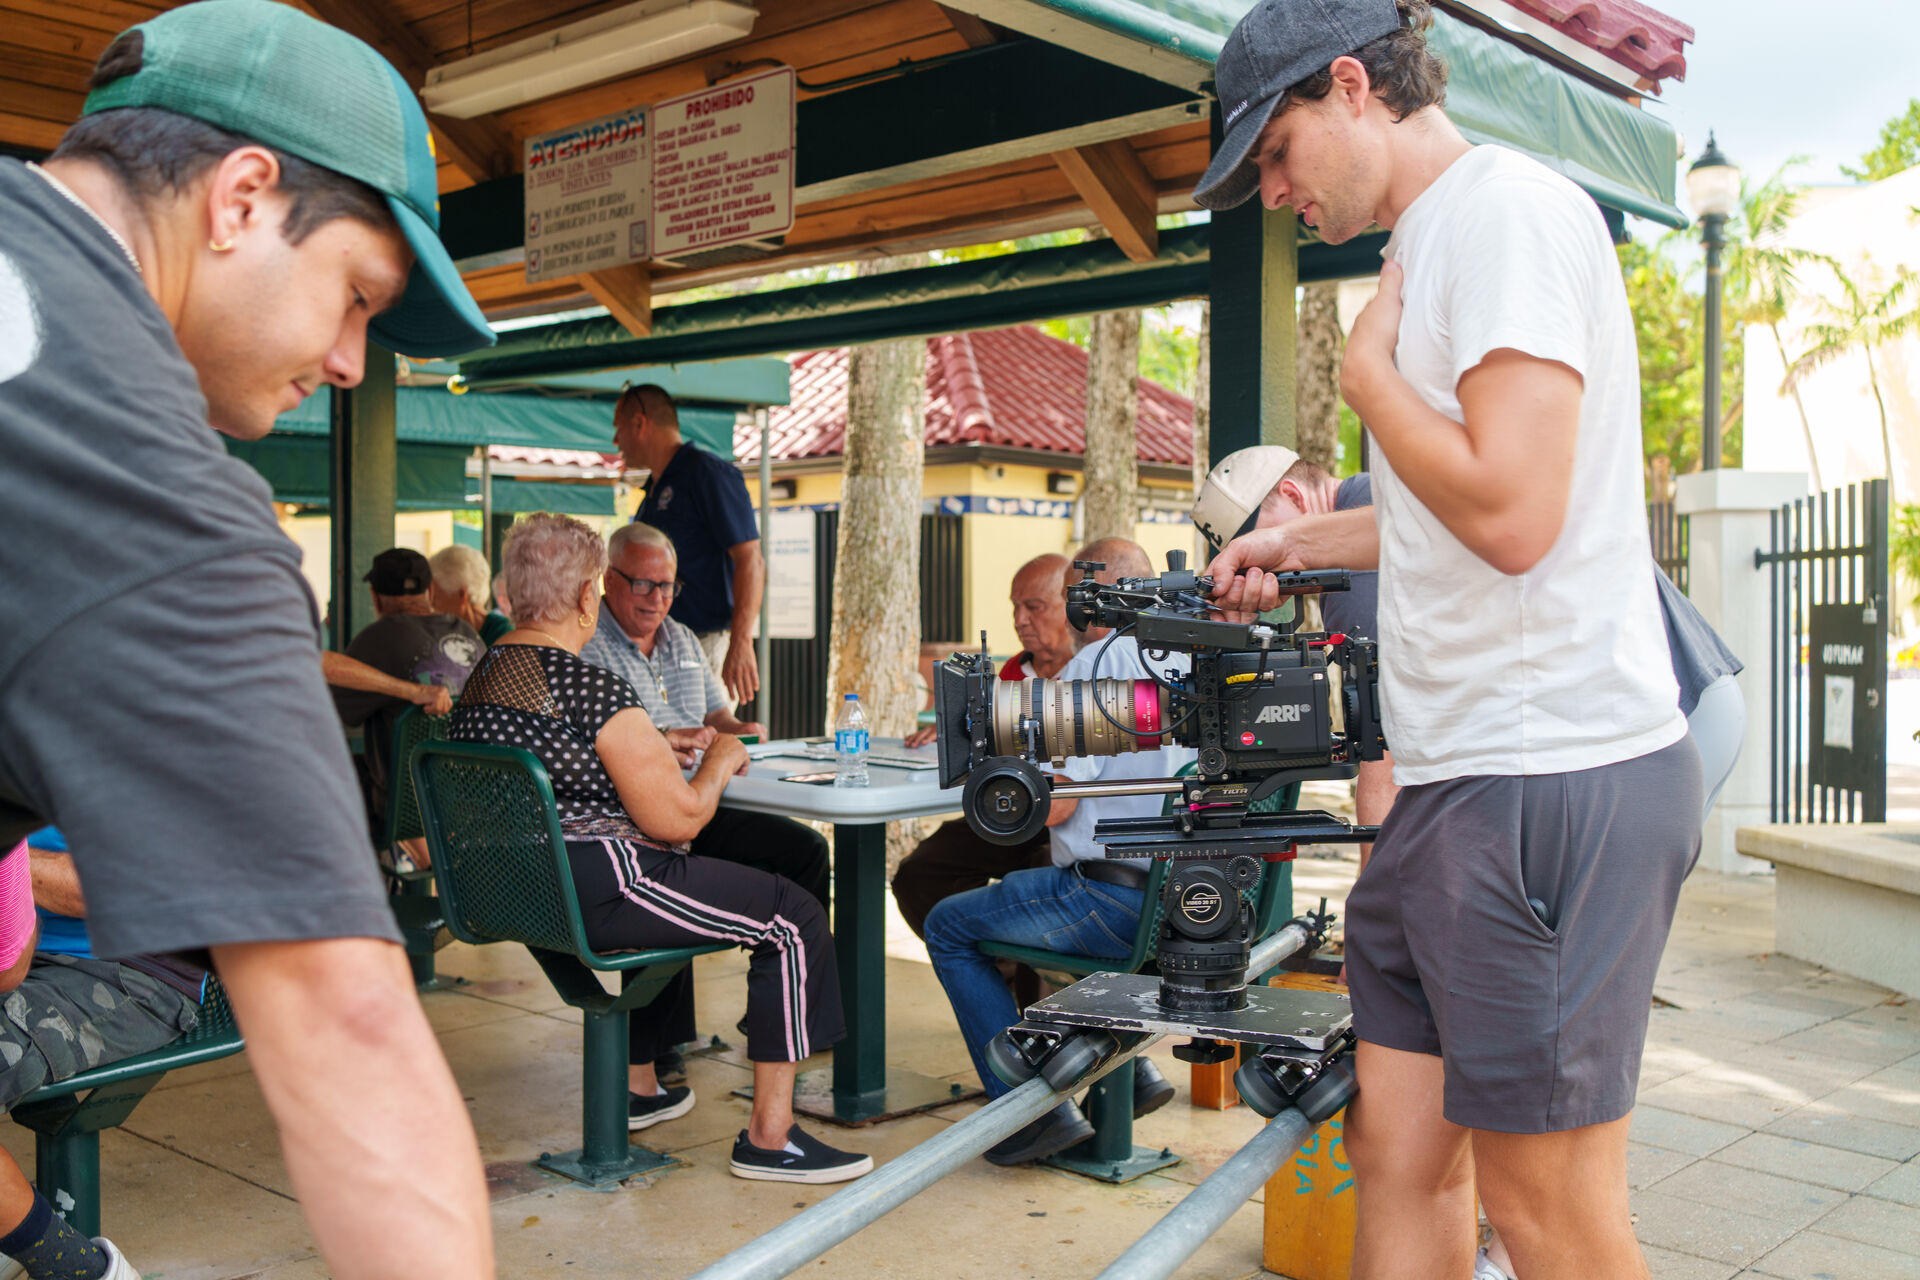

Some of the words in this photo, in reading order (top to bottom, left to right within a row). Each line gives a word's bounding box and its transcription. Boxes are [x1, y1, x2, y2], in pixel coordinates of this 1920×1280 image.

[685, 86, 754, 119] PROHIBIDO
[529, 112, 645, 169] ATENCION
[587, 148, 637, 168] MIEMBROS
[711, 204, 719, 214] DE
[745, 192, 771, 206] REGLAS
[733, 205, 775, 221] SUSPENSION
[688, 234, 696, 244] DE
[719, 222, 750, 237] SEMANAS
[1254, 704, 1300, 724] ARRI
